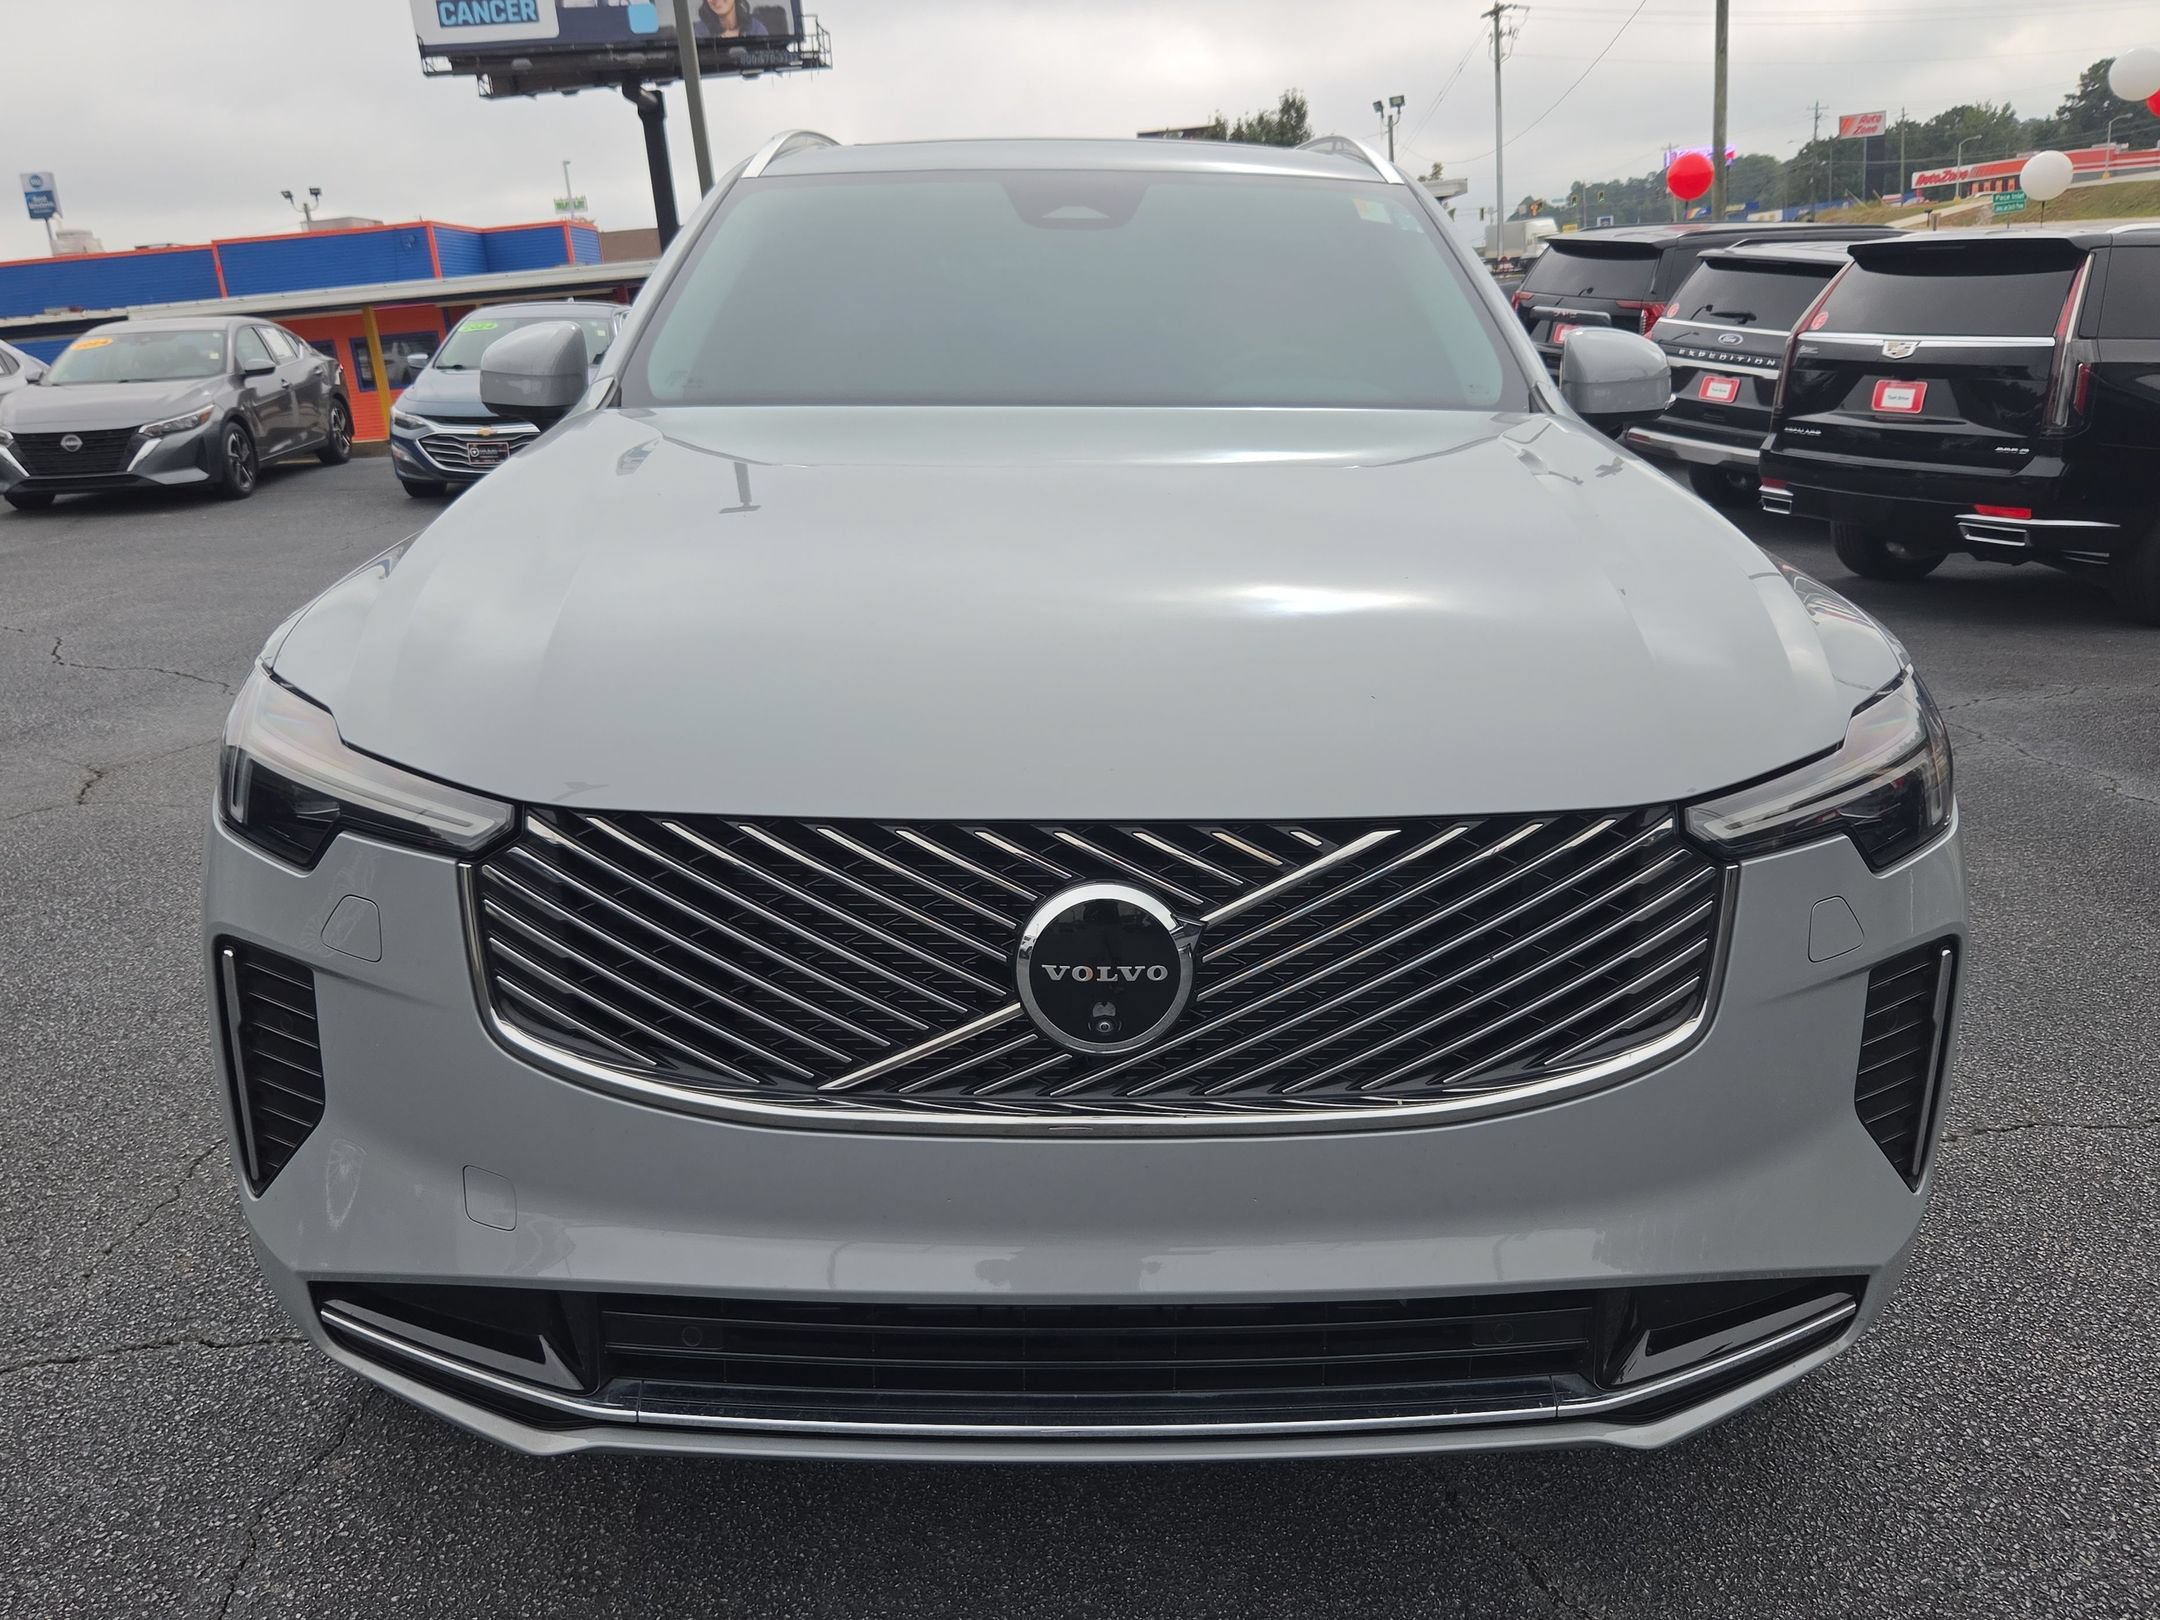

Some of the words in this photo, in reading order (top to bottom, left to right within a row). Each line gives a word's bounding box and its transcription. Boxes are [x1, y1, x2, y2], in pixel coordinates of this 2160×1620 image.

[438, 0, 537, 26] CANCER
[1859, 114, 1882, 125] Auto
[1678, 348, 1777, 367] EXPEDITION
[1041, 964, 1169, 982] VOLVO
